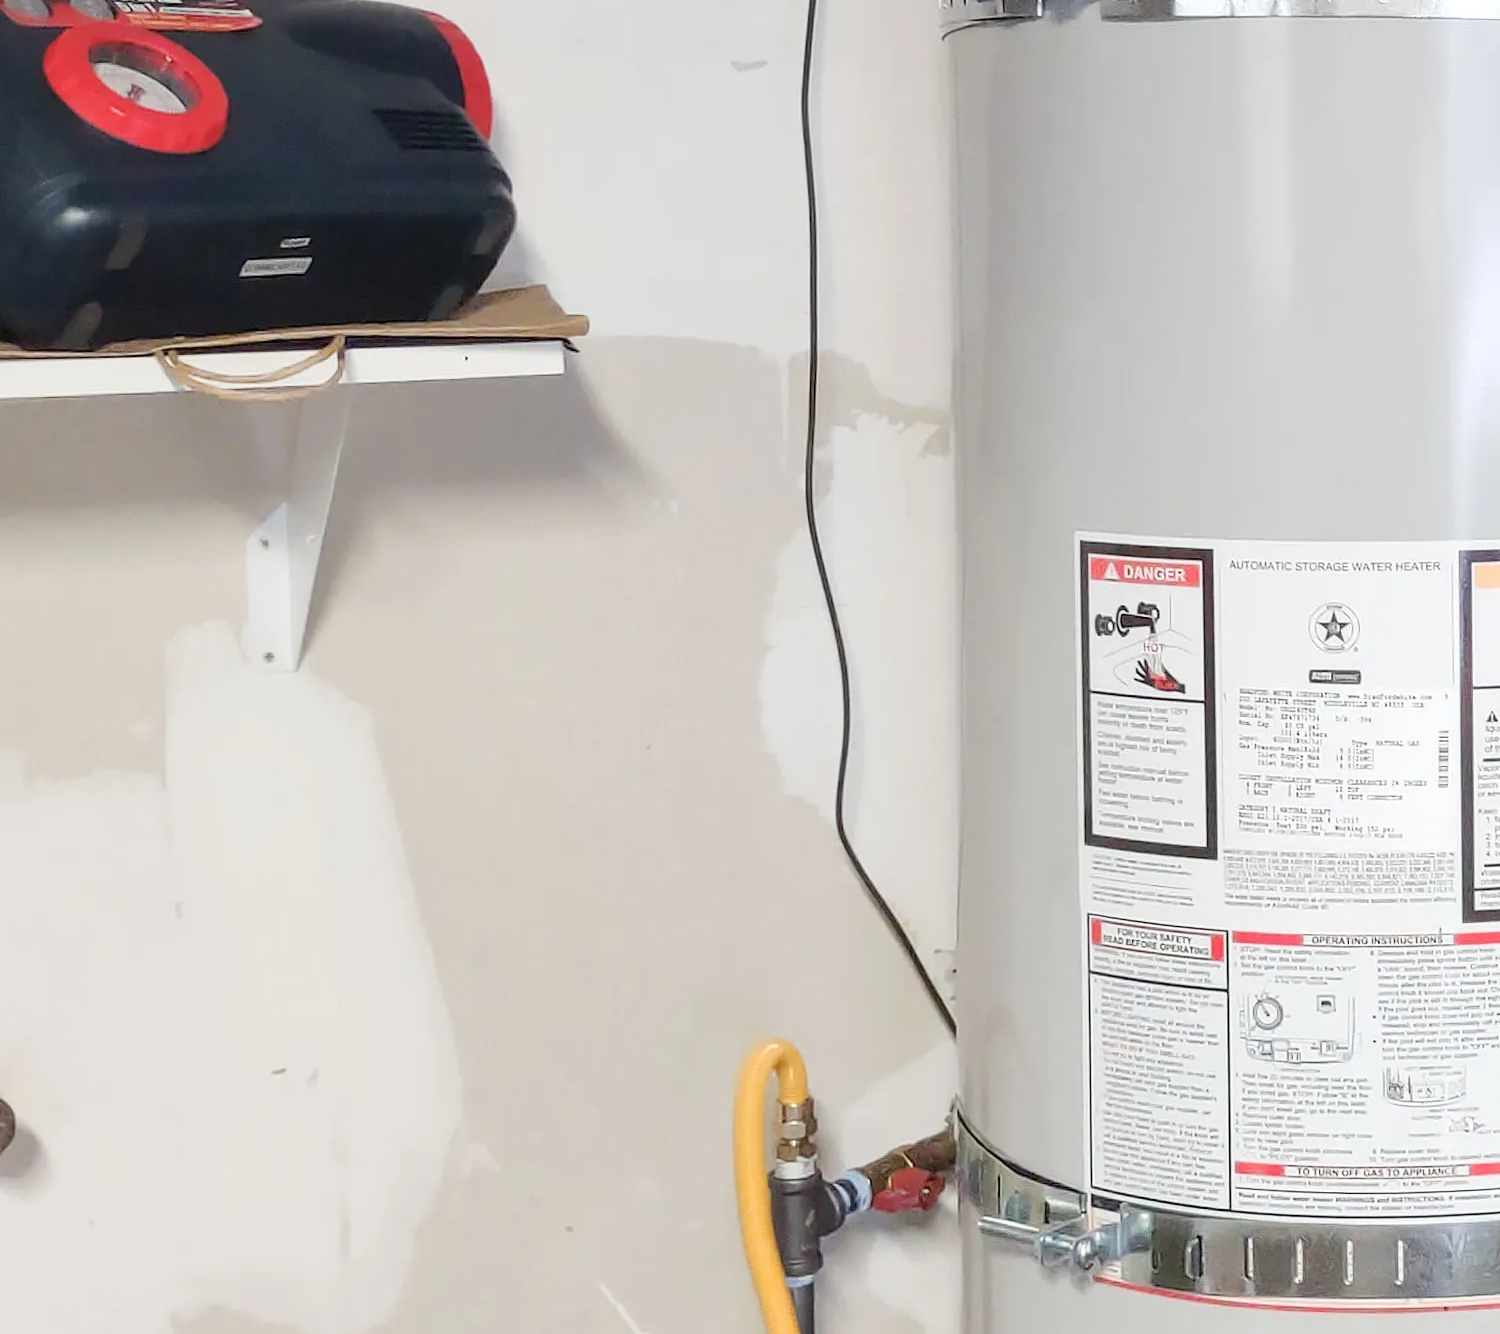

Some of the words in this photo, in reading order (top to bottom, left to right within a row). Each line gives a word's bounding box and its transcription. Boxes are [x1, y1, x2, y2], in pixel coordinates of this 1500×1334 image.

[1229, 559, 1293, 572] AUTOMATIC
[1294, 561, 1349, 573] STORAGE
[1350, 561, 1393, 573] WATER
[1394, 560, 1442, 572] HEATER
[1123, 564, 1187, 583] DANGER
[1142, 642, 1165, 653] HOT
[1116, 927, 1135, 939] FOR
[1135, 929, 1159, 941] YOUR
[1159, 931, 1193, 945] SAFETY
[1310, 935, 1370, 947] OPERATING
[1370, 934, 1444, 946] INSTRUCTIONS
[1102, 933, 1125, 946] READ
[1125, 937, 1159, 951] BEFORE
[1159, 941, 1211, 957] OPERATING
[1296, 1166, 1311, 1176] TO
[1313, 1167, 1340, 1177] TURN
[1340, 1168, 1360, 1177] OFF
[1362, 1167, 1385, 1178] GAS
[1386, 1167, 1401, 1177] TO
[1402, 1166, 1458, 1177] APPLIANCE
